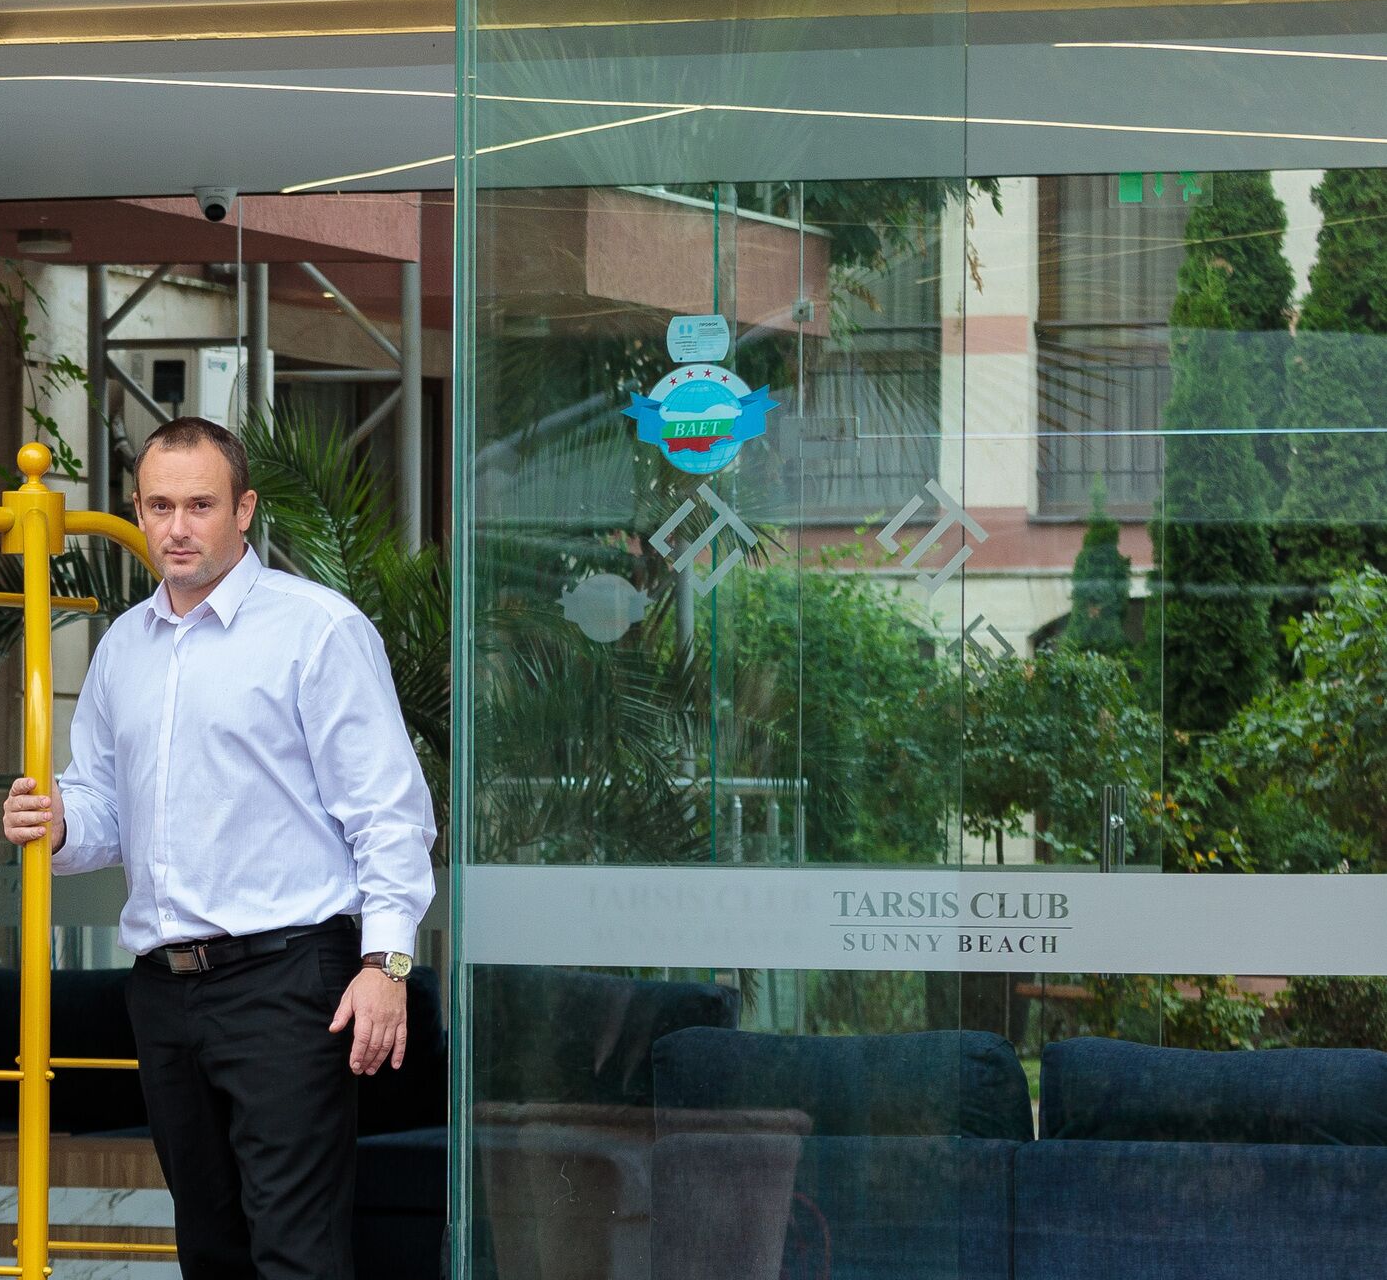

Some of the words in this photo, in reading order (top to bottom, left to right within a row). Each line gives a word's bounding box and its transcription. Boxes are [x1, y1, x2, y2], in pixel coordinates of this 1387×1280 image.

[674, 421, 721, 437] BAET
[833, 891, 960, 919] TARSIS
[970, 892, 1070, 920] CLUB
[843, 933, 943, 952] SUNNY
[958, 934, 1058, 954] BEACH
